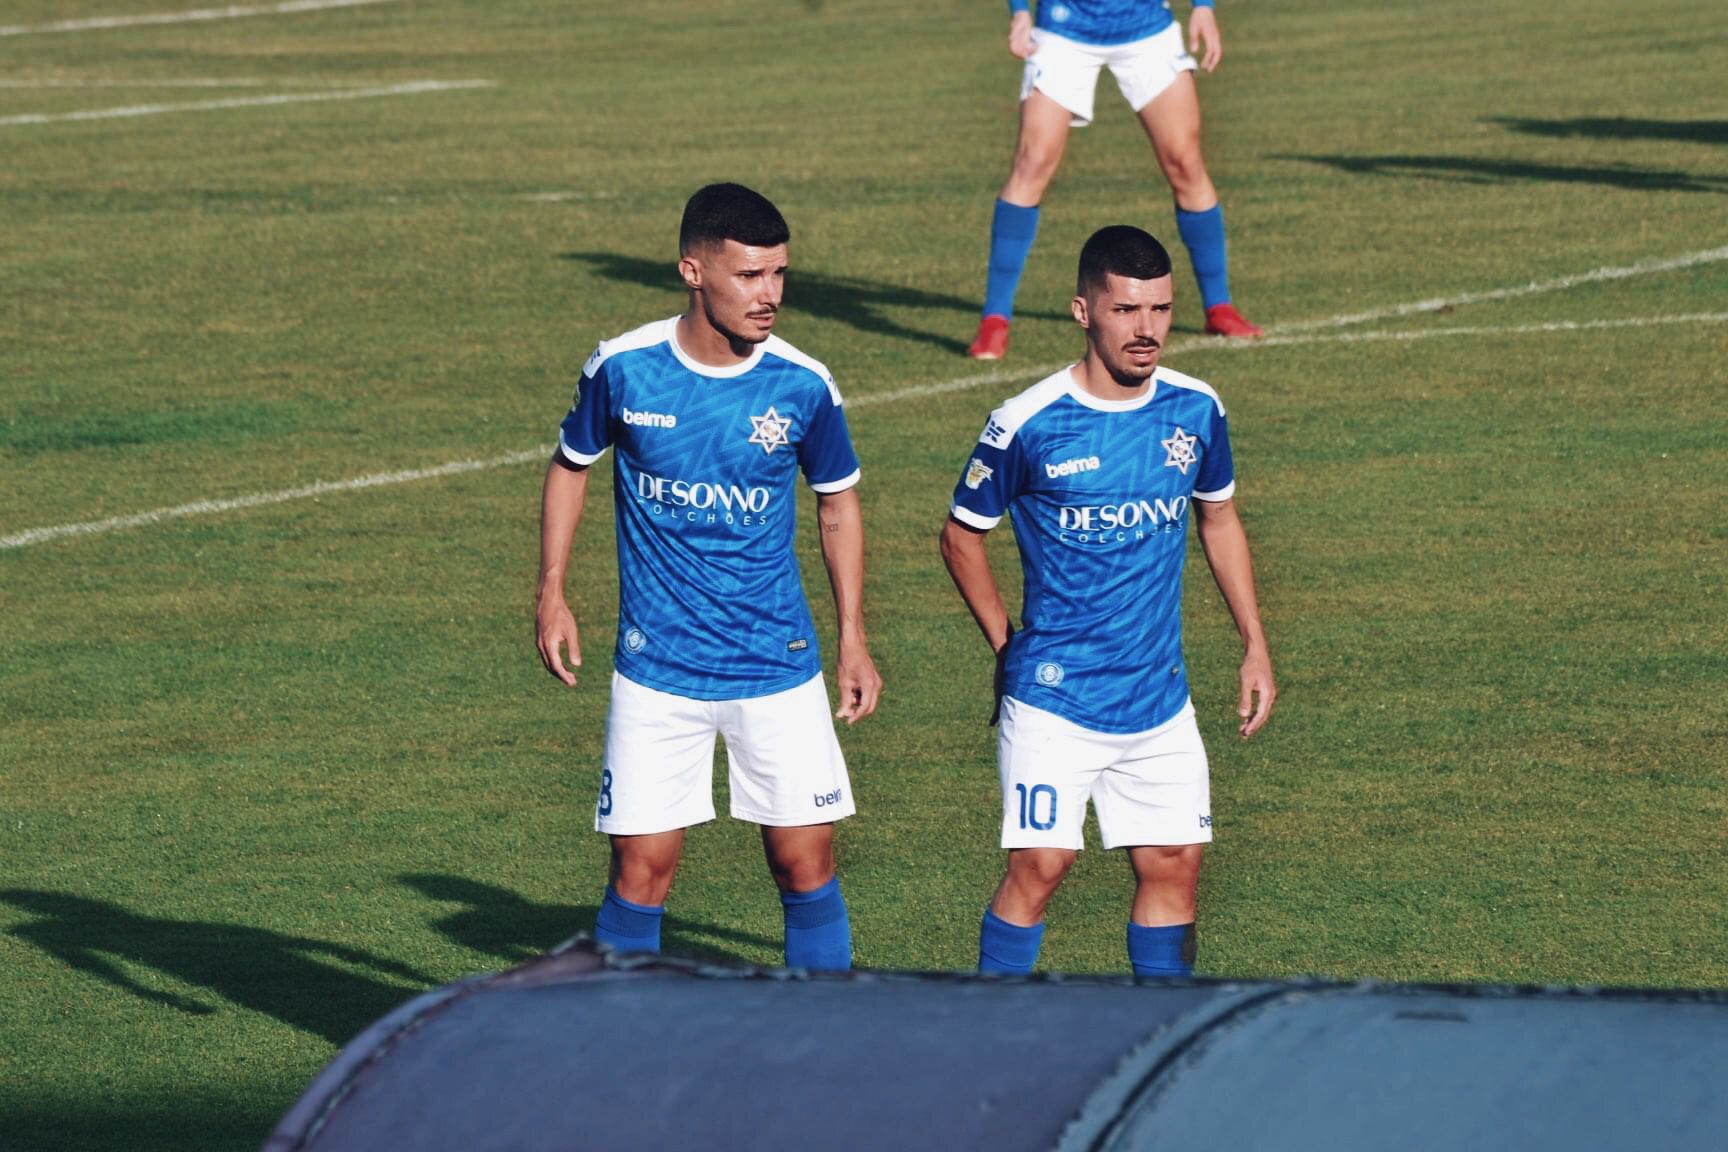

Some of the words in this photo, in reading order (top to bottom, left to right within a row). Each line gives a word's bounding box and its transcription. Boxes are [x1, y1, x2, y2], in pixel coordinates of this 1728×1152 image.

[638, 472, 769, 512] DESONNO
[637, 499, 768, 526] OLCHÕES
[1059, 496, 1187, 531] DESONNO
[1016, 782, 1057, 830] 10
